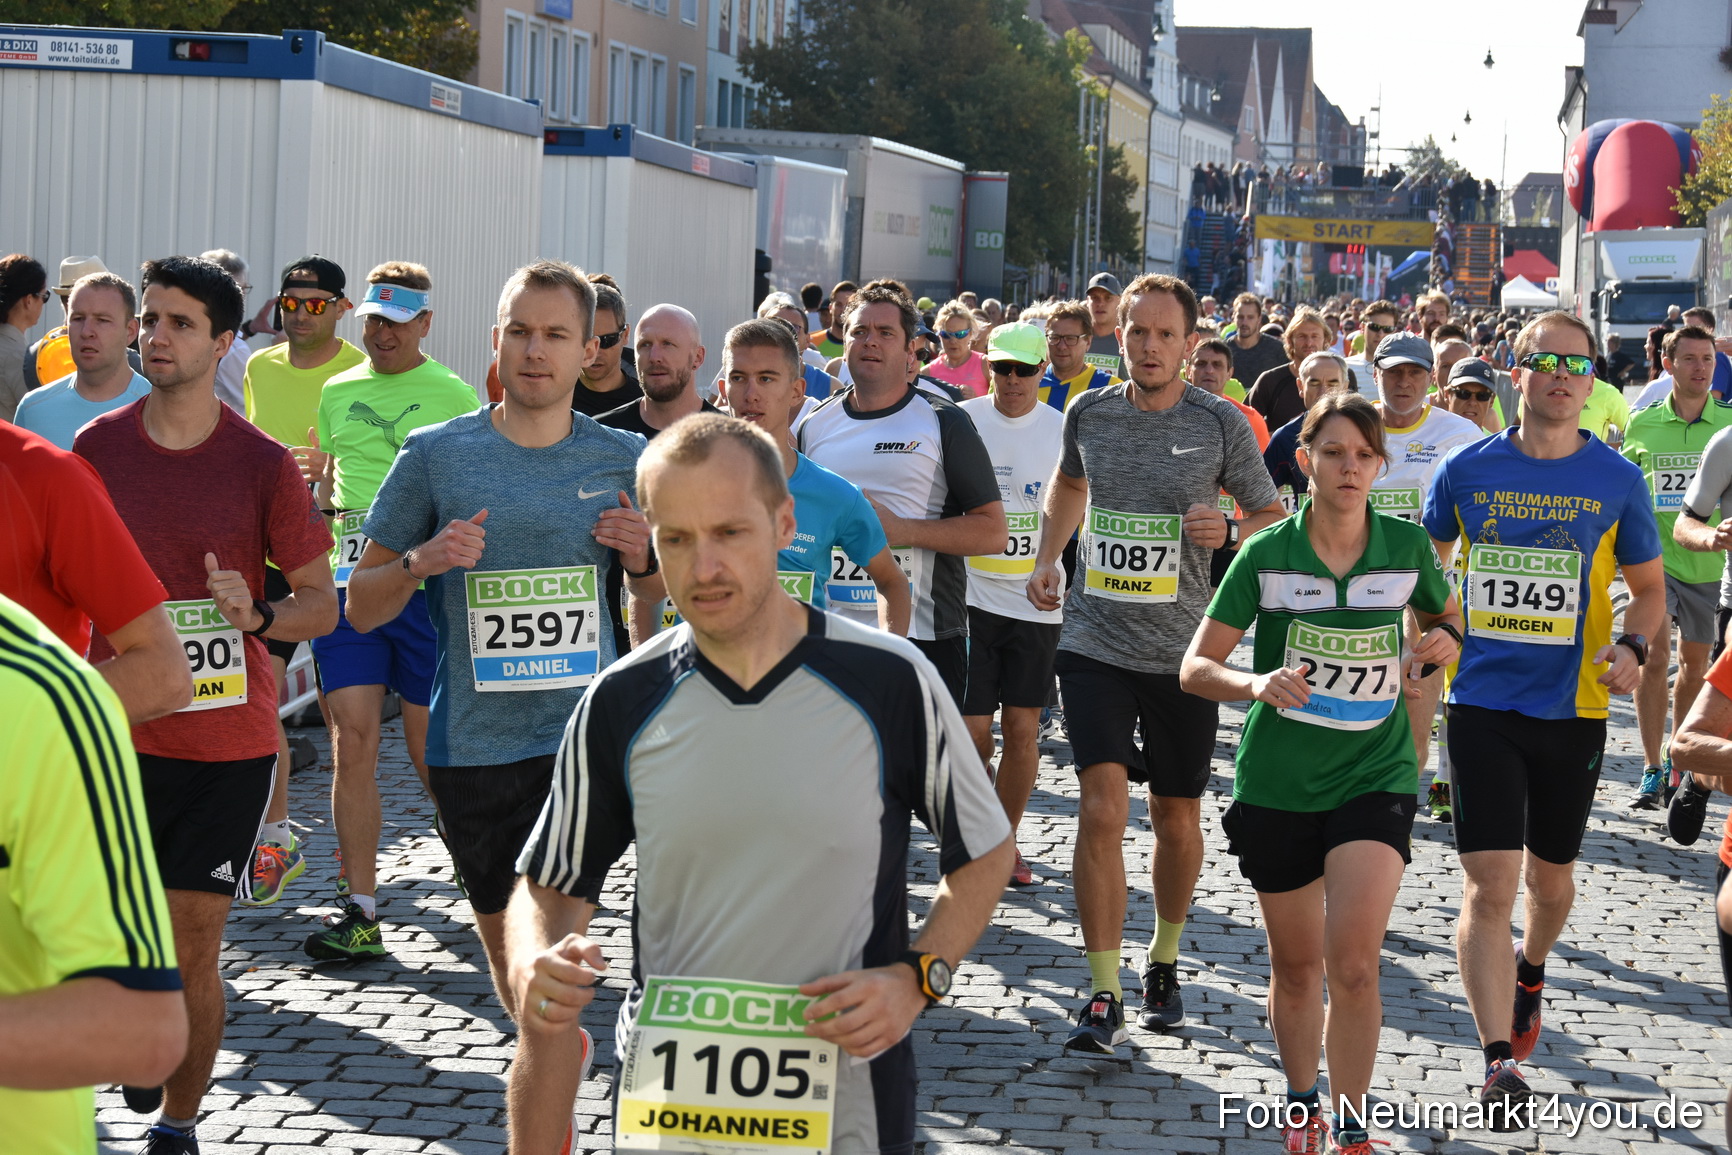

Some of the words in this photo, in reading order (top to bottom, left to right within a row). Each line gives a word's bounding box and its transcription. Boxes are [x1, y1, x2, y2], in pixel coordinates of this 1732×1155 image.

[12, 41, 37, 51] DIXI
[106, 44, 118, 55] 80
[48, 54, 120, 65] www.toitoidixi.de
[1313, 222, 1375, 239] START
[1628, 255, 1677, 264] BOCK
[874, 442, 905, 451] swn
[1408, 443, 1423, 453] 20
[1657, 454, 1702, 469] BOC
[1661, 473, 1696, 491] 22
[1368, 491, 1414, 508] OCK
[1472, 491, 1490, 504] 10.
[1493, 490, 1602, 515] NEUMARKTER
[1661, 496, 1684, 505] THO
[1488, 503, 1579, 522] STADTLAUF
[1007, 514, 1035, 530] CK
[1095, 512, 1172, 538] BOCK
[793, 532, 816, 543] DERER
[1003, 536, 1031, 557] 03
[1097, 541, 1168, 572] 1087
[1478, 549, 1571, 576] BOCK
[476, 572, 588, 604] BOCK
[1104, 577, 1152, 592] FRANZ
[1481, 579, 1566, 612] 1349
[167, 605, 231, 630] CK
[1487, 615, 1554, 633] JÜRGEN
[484, 609, 584, 650] 2597
[1296, 626, 1392, 656] BOCK
[183, 637, 231, 673] 90
[502, 658, 573, 677] DANIEL
[1299, 656, 1388, 696] 2777
[194, 681, 224, 698] AN
[210, 870, 236, 883] adidas
[650, 984, 810, 1032] BOCK
[818, 1054, 827, 1064] B
[651, 1040, 811, 1100] 1105
[639, 1109, 810, 1140] JOHANNES
